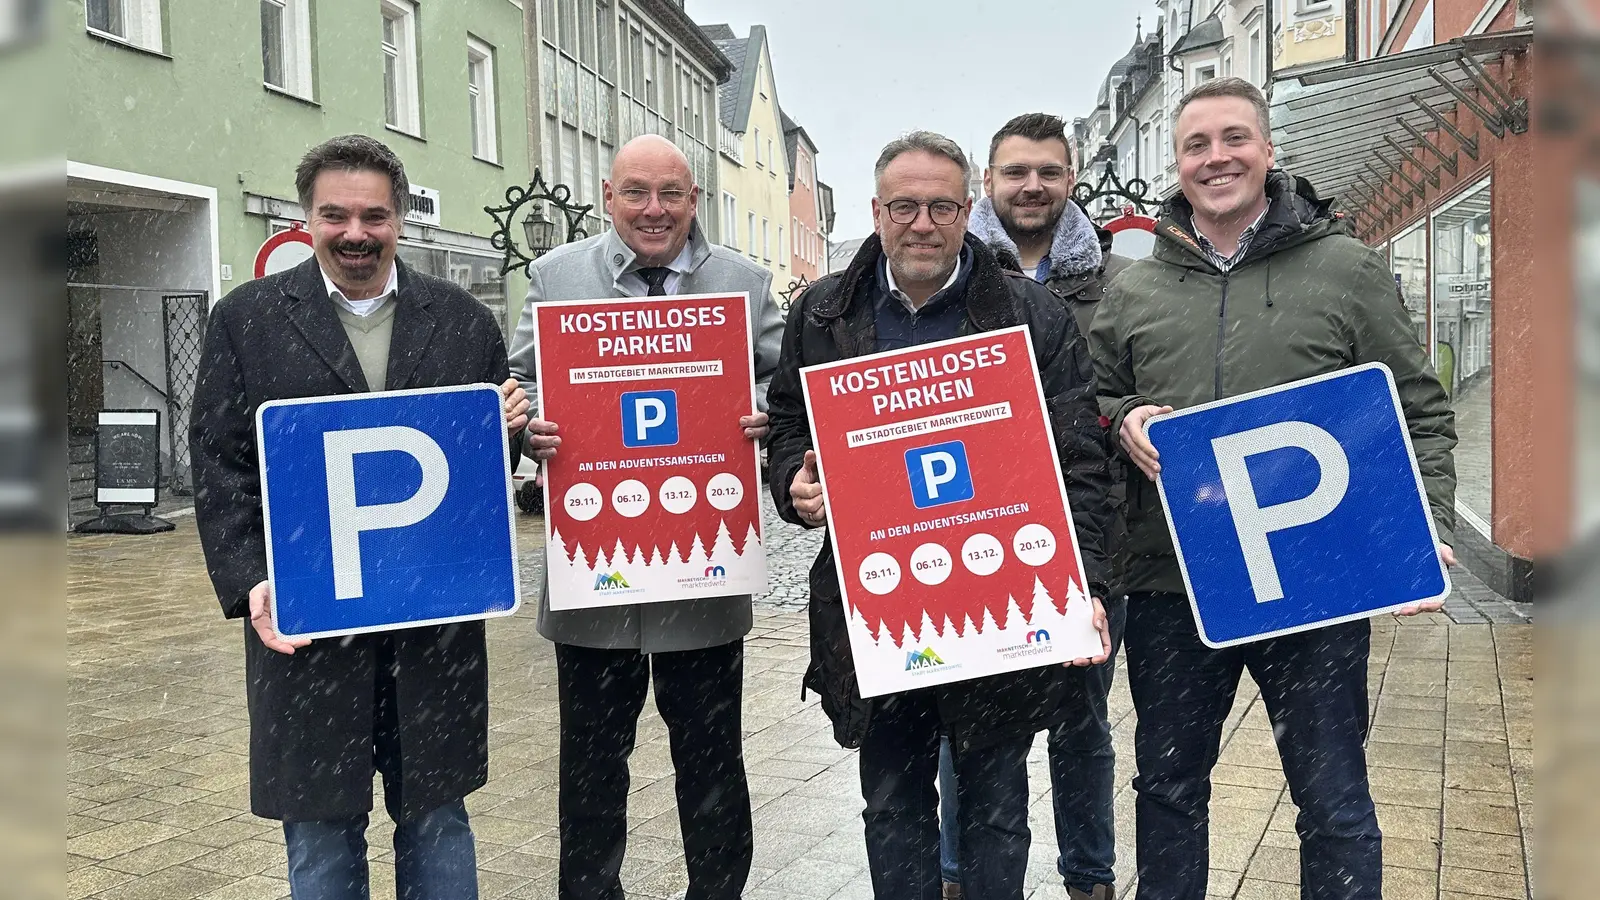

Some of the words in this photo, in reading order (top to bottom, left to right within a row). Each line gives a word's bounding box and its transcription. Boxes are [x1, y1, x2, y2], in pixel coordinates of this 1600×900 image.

[560, 306, 726, 333] KOSTENLOSES
[598, 333, 692, 357] PARKEN
[574, 371, 586, 380] IM
[587, 368, 645, 379] STADTGEBIET
[648, 364, 719, 375] MARKTREDWITZ
[829, 343, 1007, 396] KOSTENLOSES
[872, 377, 975, 416] PARKEN
[634, 397, 667, 440] P
[851, 433, 865, 443] IM
[866, 421, 928, 441] STADTGEBIET
[930, 406, 1007, 428] MARKTREDWITZ
[578, 462, 594, 472] AN
[596, 460, 617, 471] DEN
[619, 453, 726, 469] ADVENTSSAMSTAGEN
[920, 451, 957, 499] P
[323, 425, 450, 600] P
[569, 498, 598, 507] 29.11.
[616, 494, 645, 504] 06.12.
[664, 490, 692, 500] 13.12.
[711, 487, 739, 497] 20.12.
[1210, 420, 1350, 603] P
[870, 530, 886, 541] AN
[887, 525, 911, 538] DEN
[913, 502, 1029, 533] ADVENTSSAMSTAGEN
[865, 567, 896, 580] 29.11.
[916, 558, 947, 571] 06.12.
[967, 548, 999, 561] 13.12.
[1019, 539, 1050, 552] 20.12.
[599, 580, 625, 590] MAK
[682, 580, 726, 589] marktredwitz
[910, 656, 940, 670] MAK
[1003, 645, 1053, 661] marktredwitz
